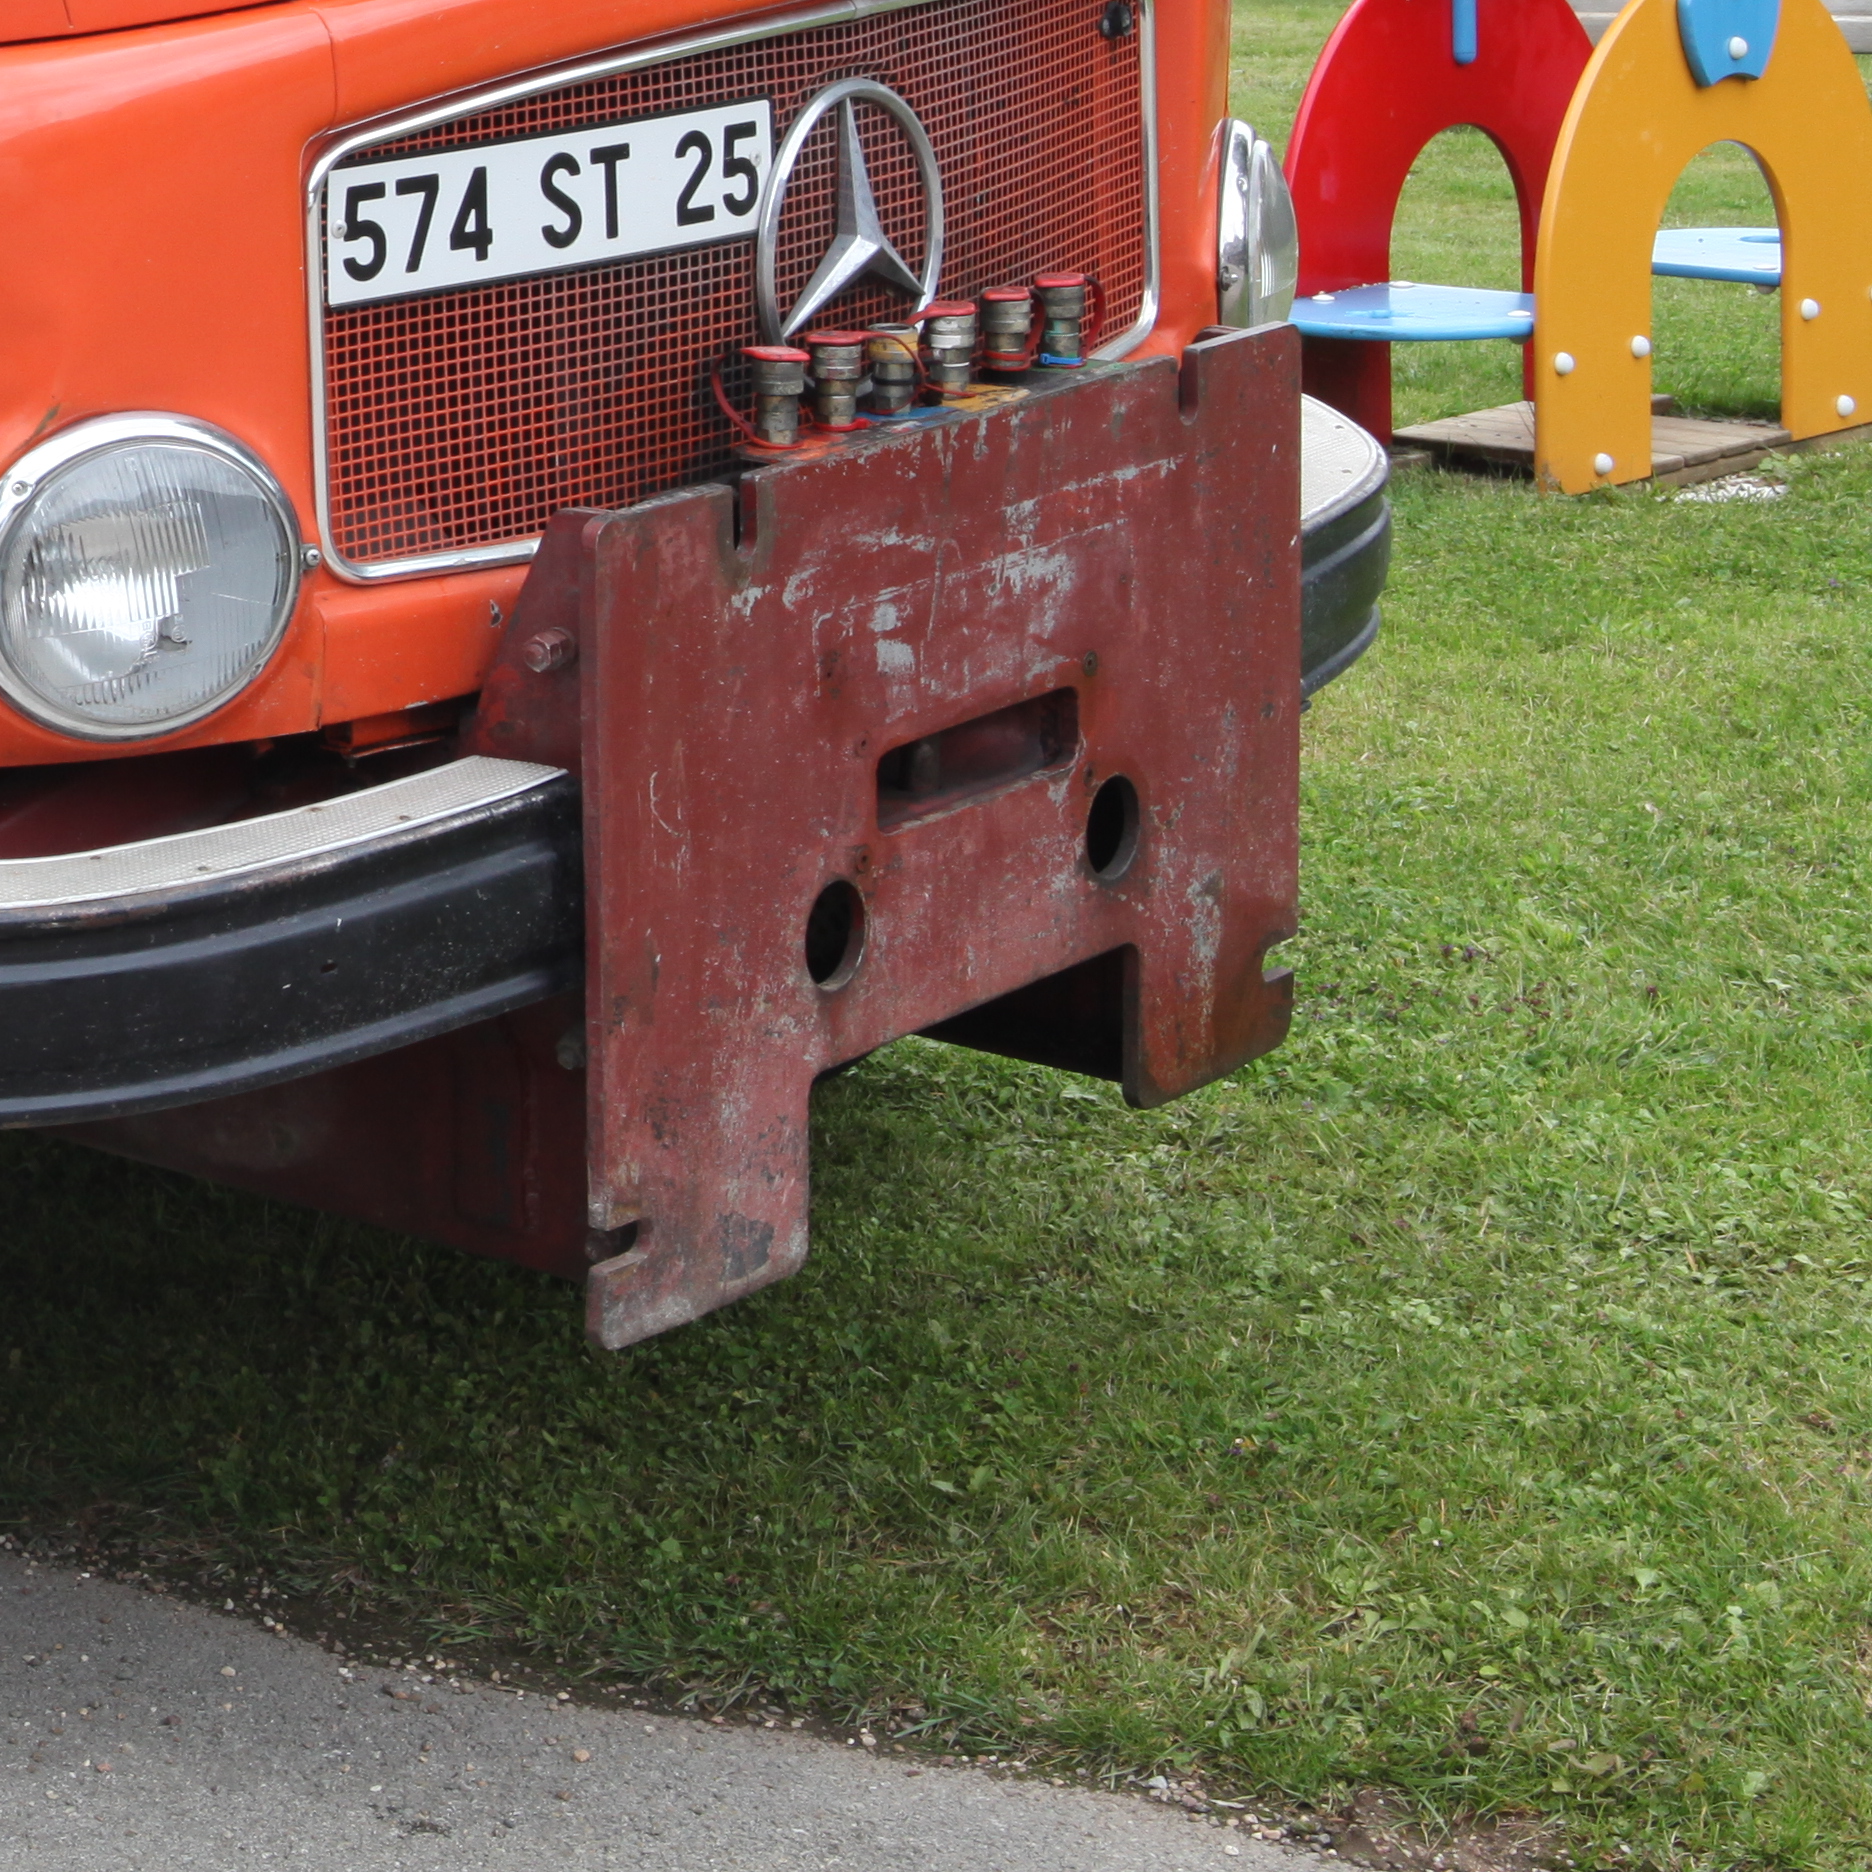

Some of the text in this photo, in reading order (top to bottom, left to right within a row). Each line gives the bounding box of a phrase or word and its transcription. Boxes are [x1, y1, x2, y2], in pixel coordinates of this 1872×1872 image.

[342, 121, 759, 282] 574 ST 25
